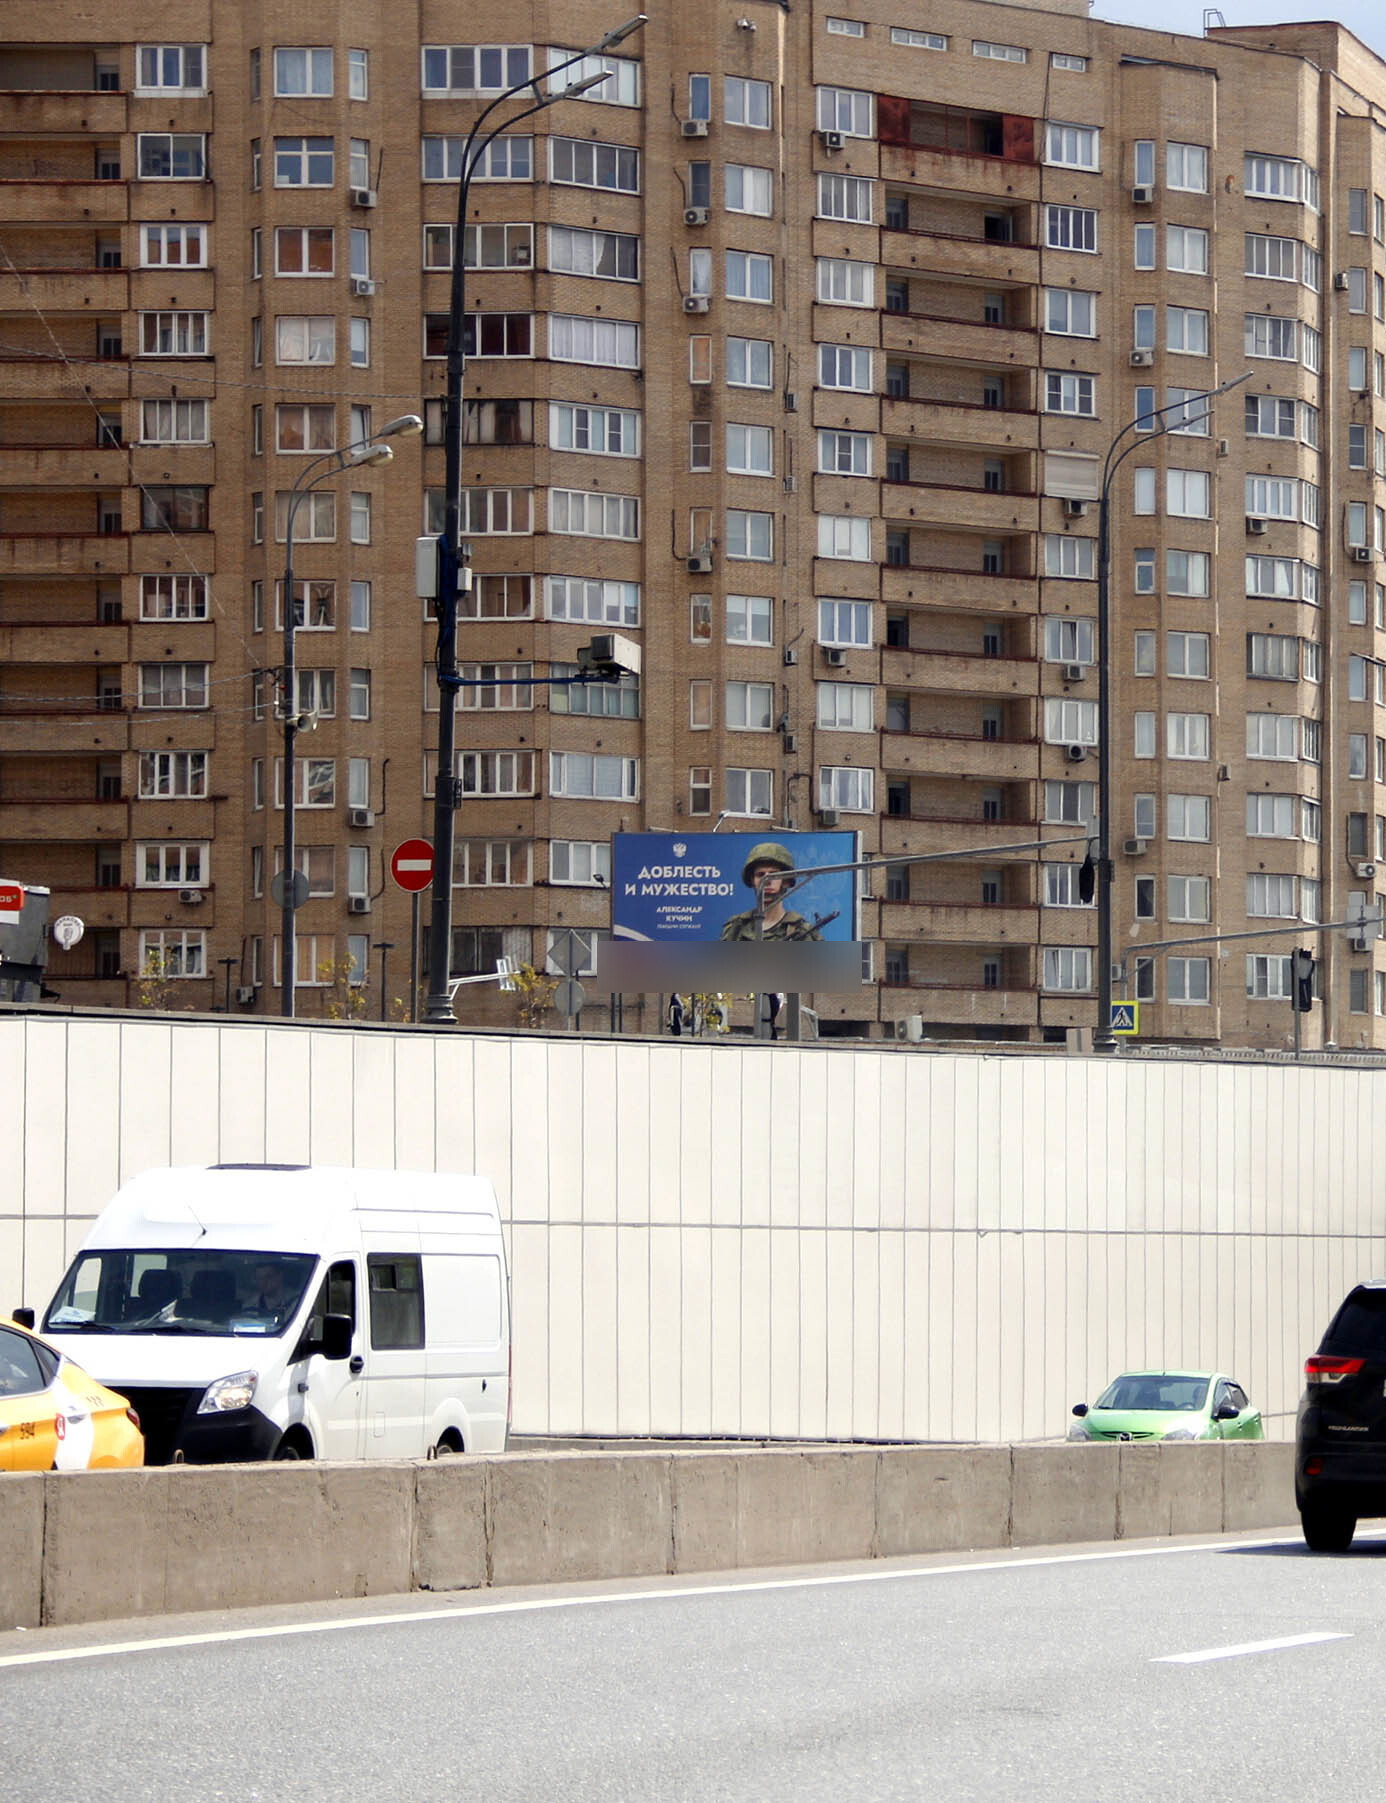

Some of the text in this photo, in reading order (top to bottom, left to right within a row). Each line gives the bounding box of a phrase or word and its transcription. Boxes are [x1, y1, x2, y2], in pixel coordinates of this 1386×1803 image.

[638, 866, 721, 879] ДОБЛЕСТЬ
[625, 883, 735, 896] И МУЖЕСТВО!
